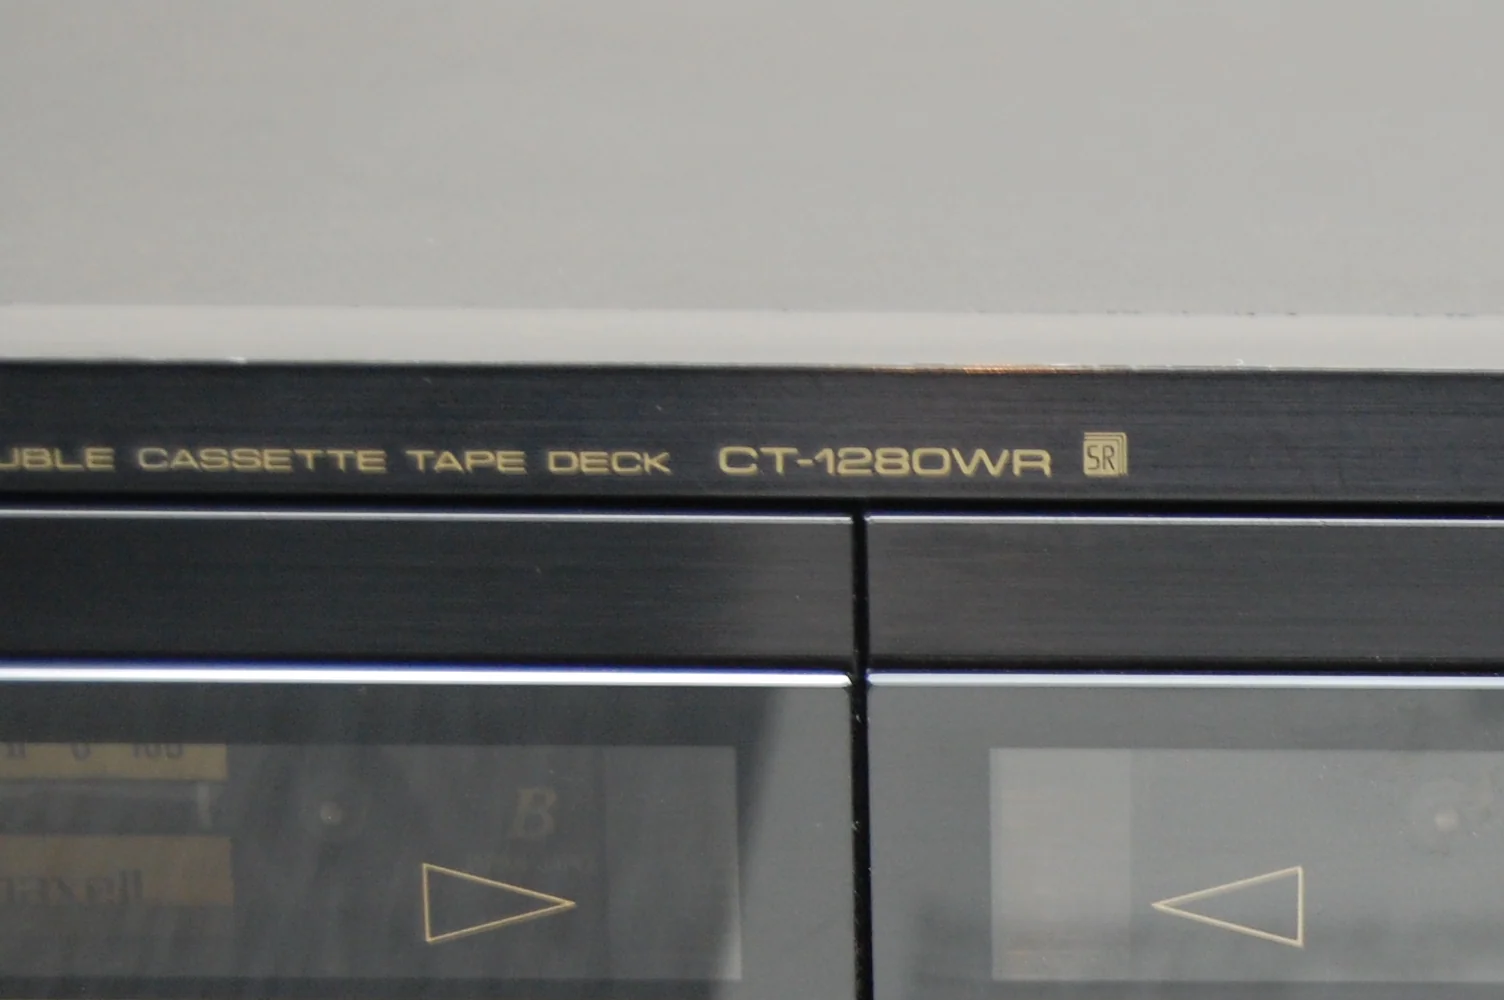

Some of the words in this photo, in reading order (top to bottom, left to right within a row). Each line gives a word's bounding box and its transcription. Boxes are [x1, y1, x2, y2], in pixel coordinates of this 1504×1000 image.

[137, 447, 388, 474] CASSETTE
[406, 449, 526, 475] TAPE
[547, 450, 671, 476] DECK
[718, 446, 1052, 477] CT-1280WR
